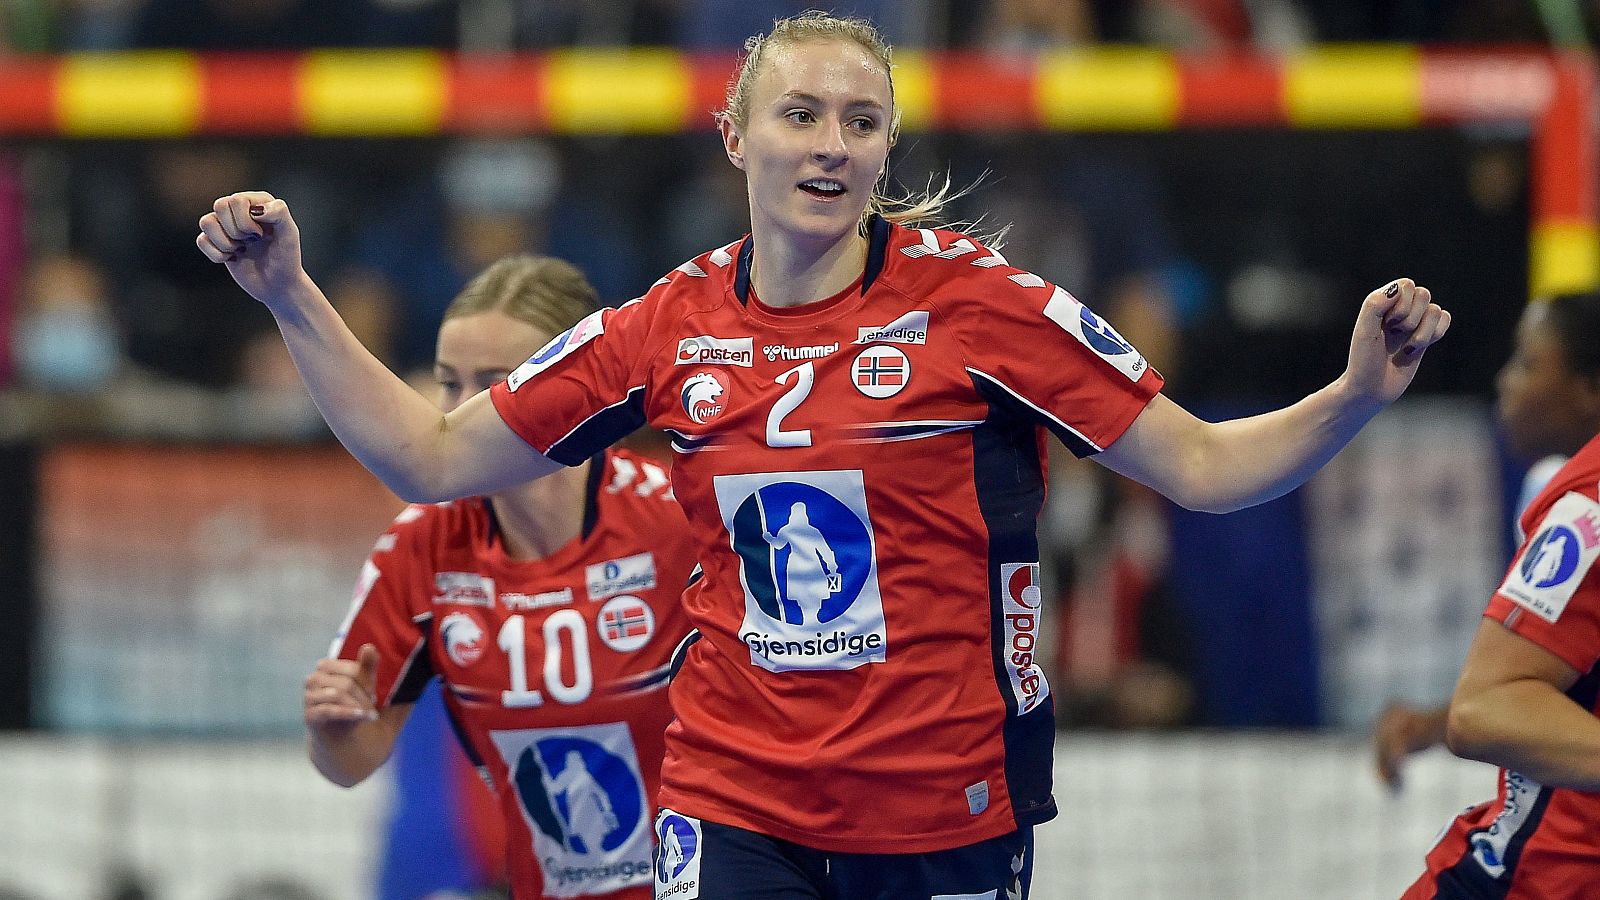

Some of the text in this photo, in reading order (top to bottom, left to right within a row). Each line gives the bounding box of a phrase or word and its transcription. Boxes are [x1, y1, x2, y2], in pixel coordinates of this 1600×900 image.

[861, 327, 926, 343] jensidige
[781, 342, 839, 361] hummel
[699, 405, 722, 418] NHF
[764, 360, 815, 448] 2
[743, 631, 881, 660] Gjensidige
[497, 608, 593, 709] 10
